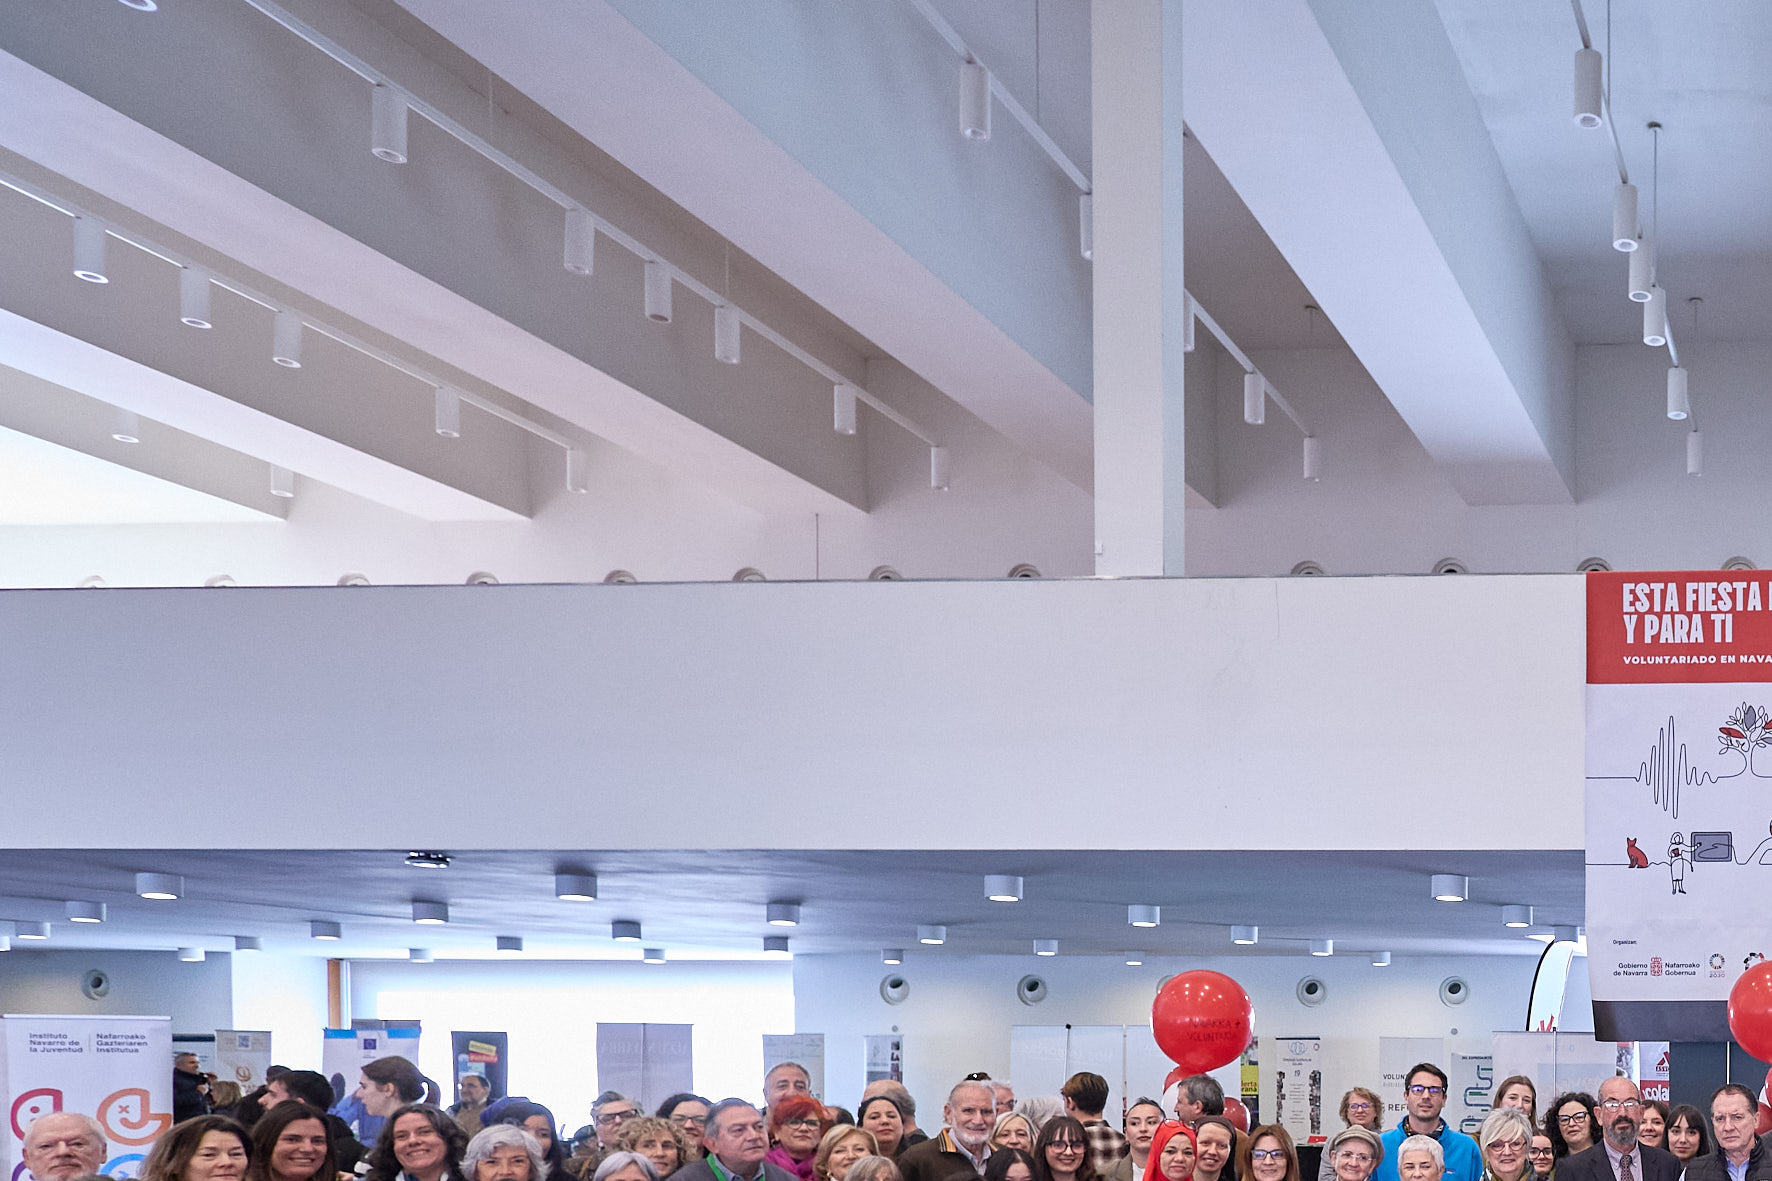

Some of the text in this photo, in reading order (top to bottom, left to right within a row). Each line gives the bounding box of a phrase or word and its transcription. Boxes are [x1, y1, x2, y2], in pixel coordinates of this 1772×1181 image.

[1622, 582, 1680, 613] ESTA
[1685, 581, 1762, 612] FIESTA
[1623, 613, 1733, 644] Y PARA TI
[1623, 655, 1717, 665] VOLUNTARIADO
[1721, 655, 1736, 664] EN
[96, 1039, 148, 1047] Gazteriaren
